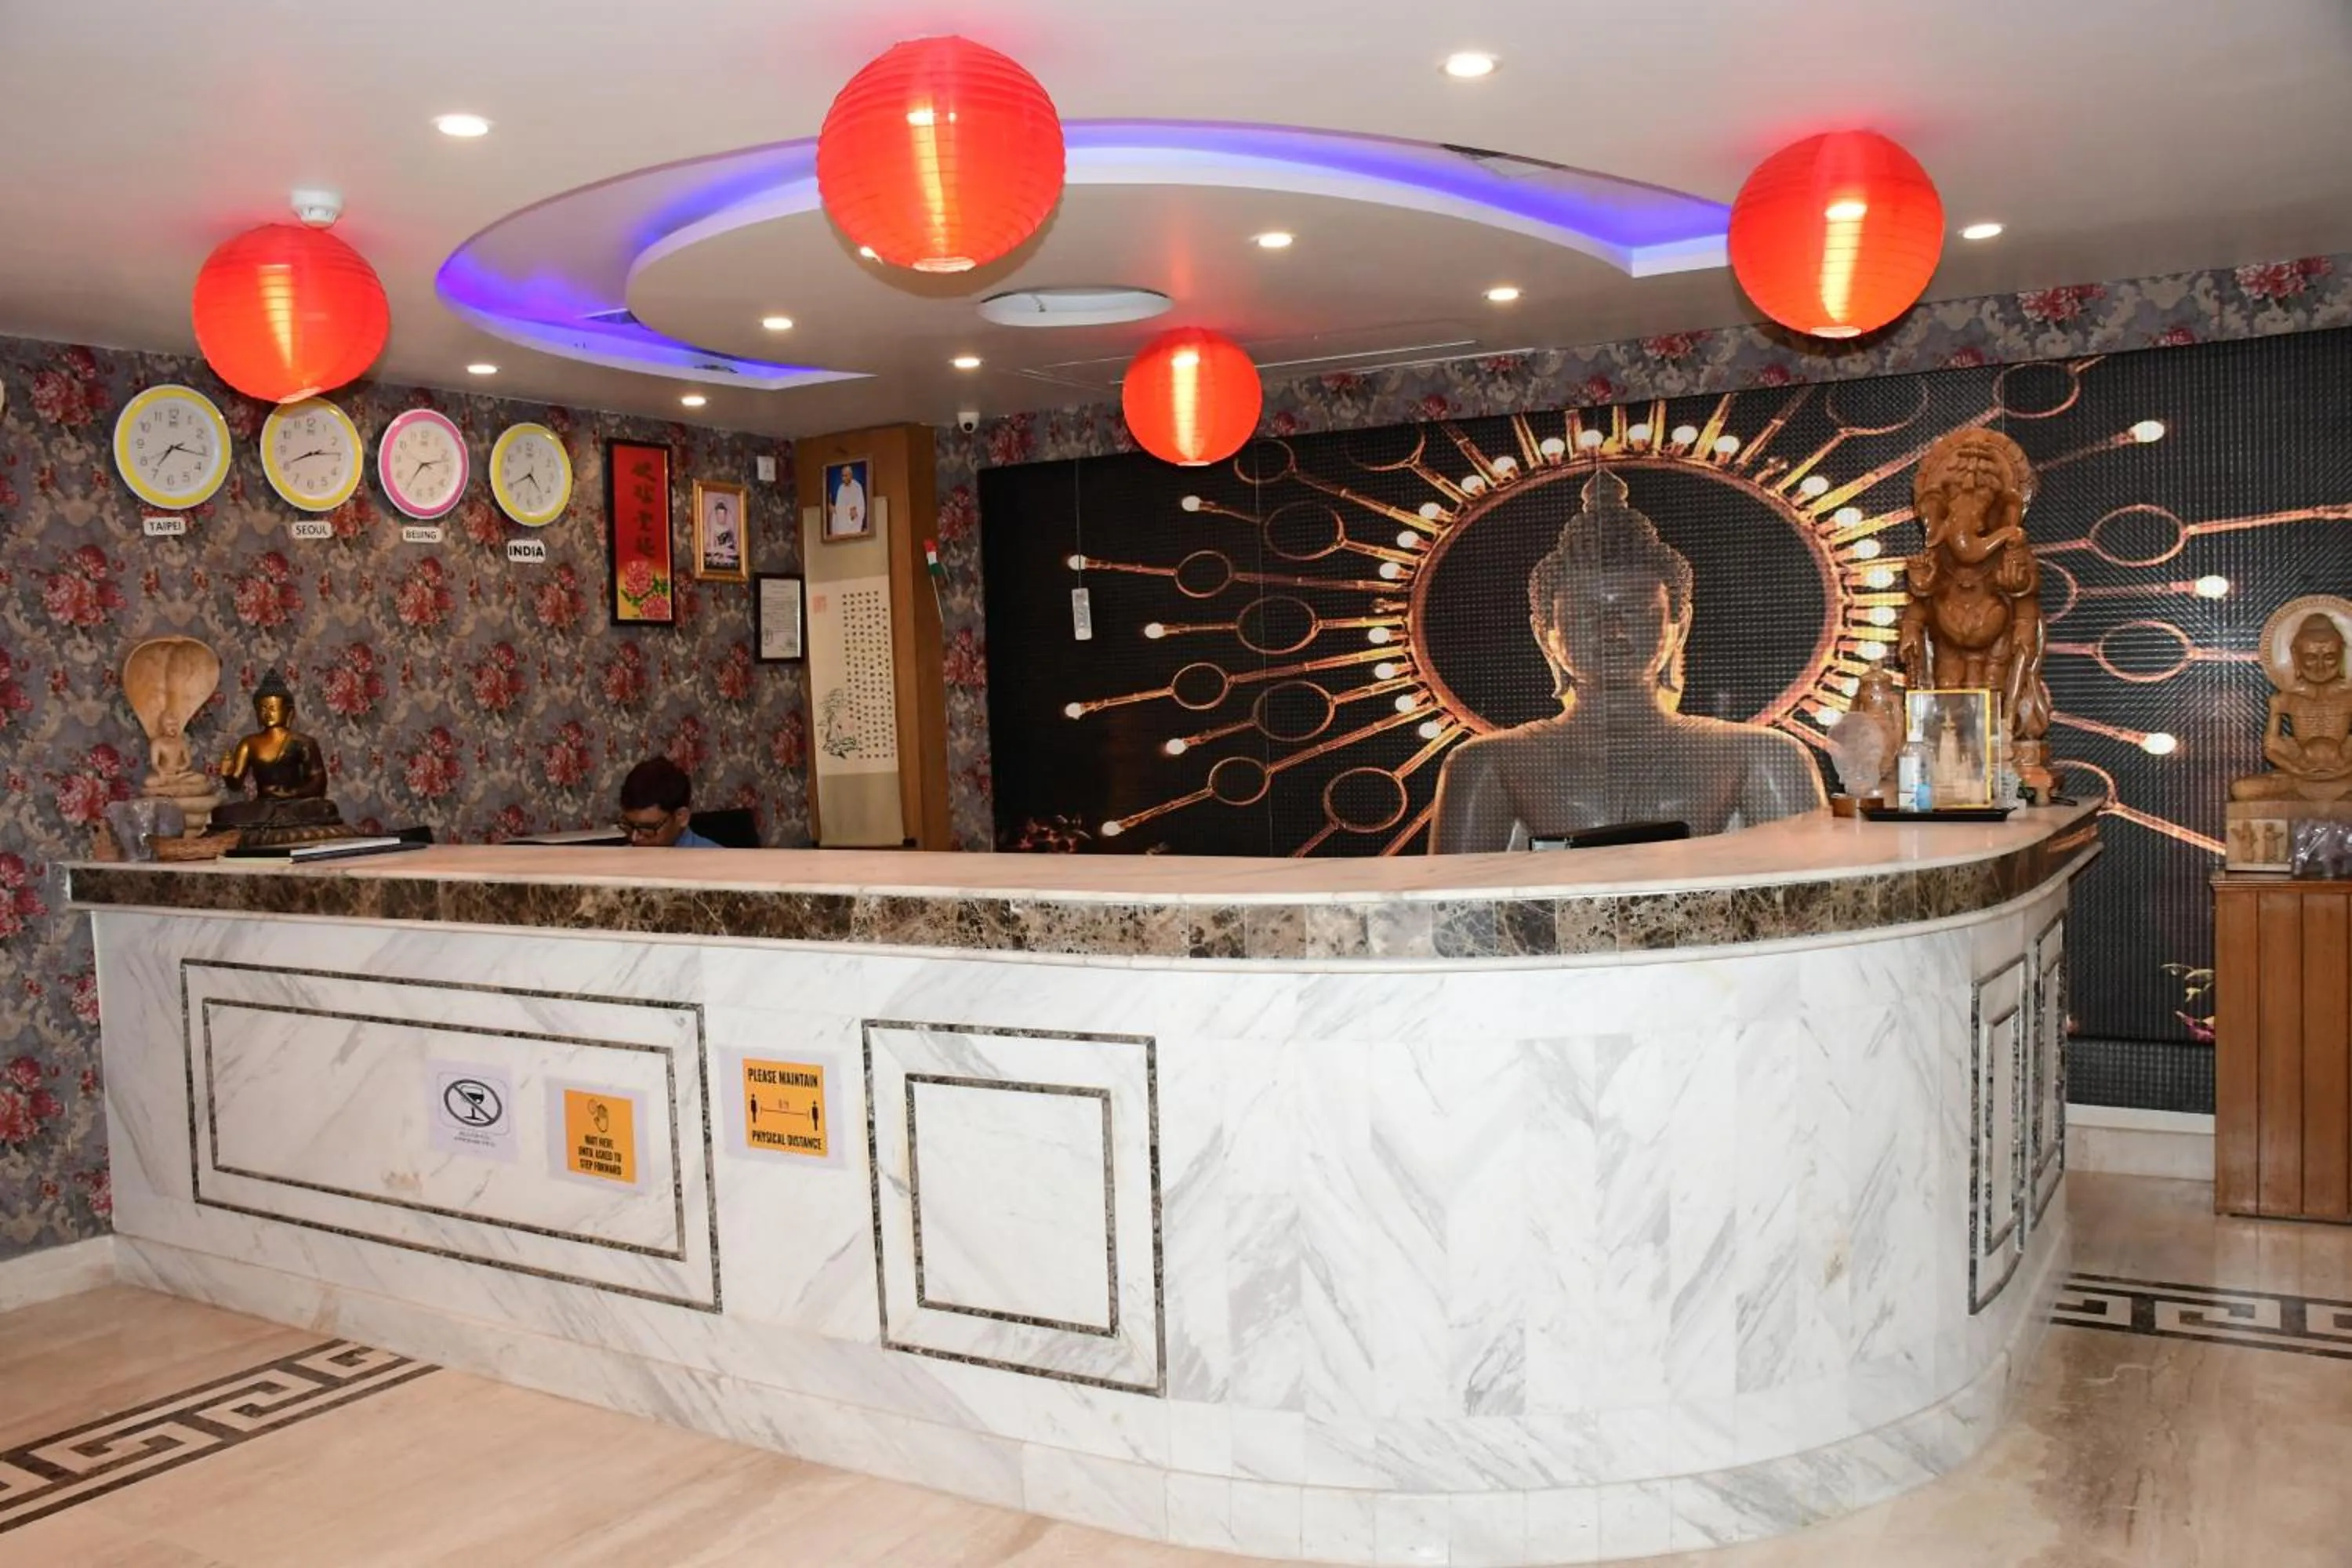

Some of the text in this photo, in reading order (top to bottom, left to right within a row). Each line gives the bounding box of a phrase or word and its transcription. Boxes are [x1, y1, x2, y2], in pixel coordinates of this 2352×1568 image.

[150, 521, 181, 532] TAIPEI
[296, 524, 328, 535] SEOUL
[510, 546, 543, 557] INDIA
[748, 1067, 818, 1087] PLEASE MAINTAIN
[752, 1130, 821, 1150] PHYSICAL DISTANCE
[594, 1160, 622, 1175] FORWARD
